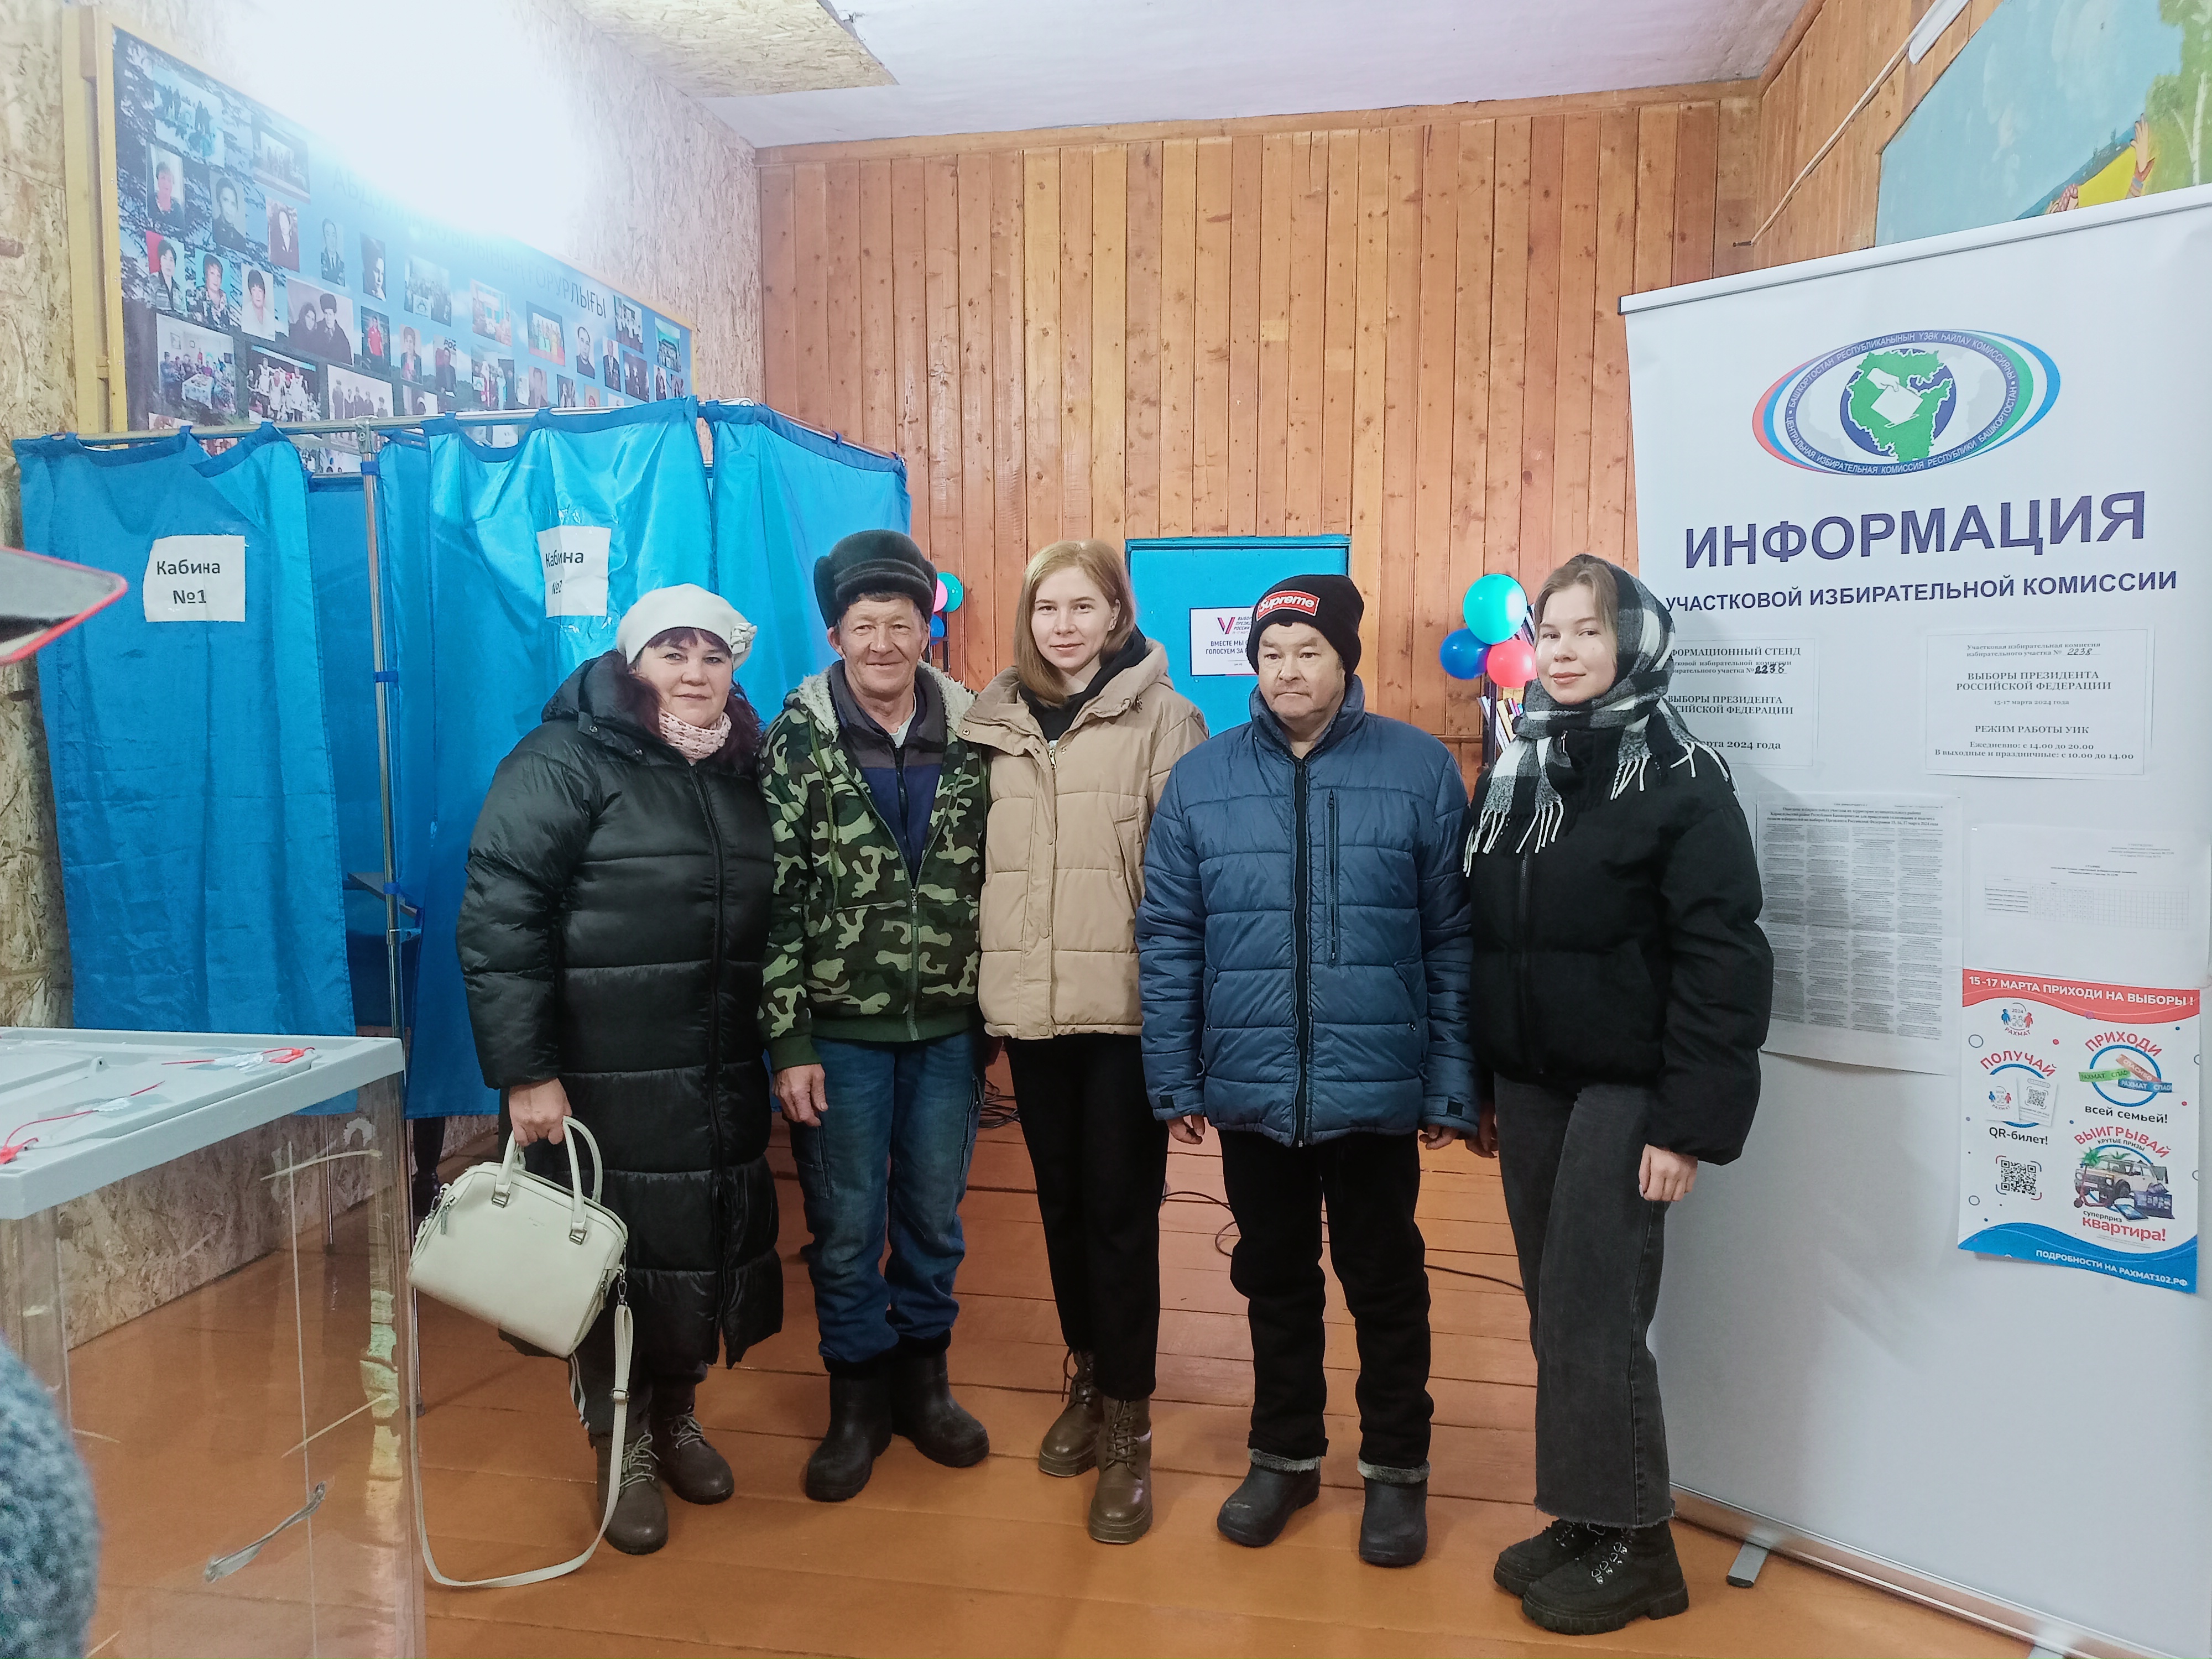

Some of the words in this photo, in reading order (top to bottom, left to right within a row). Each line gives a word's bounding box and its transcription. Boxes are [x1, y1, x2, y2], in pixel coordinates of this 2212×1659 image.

[1788, 357, 1835, 408] БАШКОРТОСТАН
[1786, 416, 1816, 459] ЦЕНТРАЛЬНАЯ
[1816, 455, 1878, 474] ИЗБИРАТЕЛЬНАЯ
[1881, 461, 1924, 474] КОМИССИЯ
[1927, 440, 1978, 467] РЕСПУБЛИКИ
[1978, 387, 2017, 442] БАШКОРТОСТАН
[1686, 491, 2145, 568] ИНФОРМАЦИЯ
[157, 559, 220, 575] Кабина
[546, 549, 583, 568] Кабина
[173, 589, 207, 604] №1
[1666, 586, 1802, 612] УЧАСТКОВОЙ
[1809, 575, 2014, 606] ИЗБИРАТЕЛЬНОЙ
[2024, 571, 2177, 595] КОМИССИИ
[1259, 596, 1314, 613] Supreme
[1671, 646, 1762, 656] ФОРМАЦИОННЫЙ
[1765, 648, 1801, 656] СТЕНД
[2067, 648, 2093, 656] 2238
[1754, 663, 1785, 674] 2238
[1968, 672, 2017, 680] ВЫБОРЫ
[2020, 671, 2099, 680] ПРЕЗИДЕНТА
[1957, 681, 2033, 691] РОССИЙСКОЙ
[2036, 681, 2111, 691] ФЕДЕРАЦИИ
[1668, 695, 1709, 703] ВЫБОРЫ
[1713, 696, 1782, 704] ПРЕЗИДЕНТА
[1676, 704, 1724, 713] СИЙСКОЙ
[1726, 706, 1793, 715] ФЕДЕРАЦИИ
[1727, 742, 1753, 750] 2024
[1969, 976, 1997, 988] 15-17
[2000, 979, 2040, 992] МАРТА
[2043, 984, 2103, 1000] ПРИХОДИ
[2106, 990, 2124, 1001] НА
[2127, 993, 2187, 1006] ВЫБОРЫ
[2005, 1027, 2031, 1036] РАХМАТ
[2085, 1031, 2162, 1057] ПРИХОДИ
[1980, 1051, 2057, 1077] ПОЛУЧАЙ
[2123, 1058, 2153, 1081] СПАСИБО
[2121, 1081, 2147, 1089] РАХМАТ
[2085, 1106, 2113, 1117] всей
[2117, 1110, 2168, 1124] семьей!
[1989, 1127, 2048, 1145] QR-билет!
[2074, 1126, 2171, 1158] ВЫИГРЫВАЙ
[2123, 1140, 2145, 1151] ПРИЗЫ
[2083, 1211, 2122, 1223] суперприз
[2083, 1217, 2166, 1241] квартира!
[2036, 1249, 2102, 1269] ПОДРОБНОСТИ
[2105, 1264, 2117, 1272] НА
[2119, 1267, 2188, 1287] РАХМАТ102.РФ
